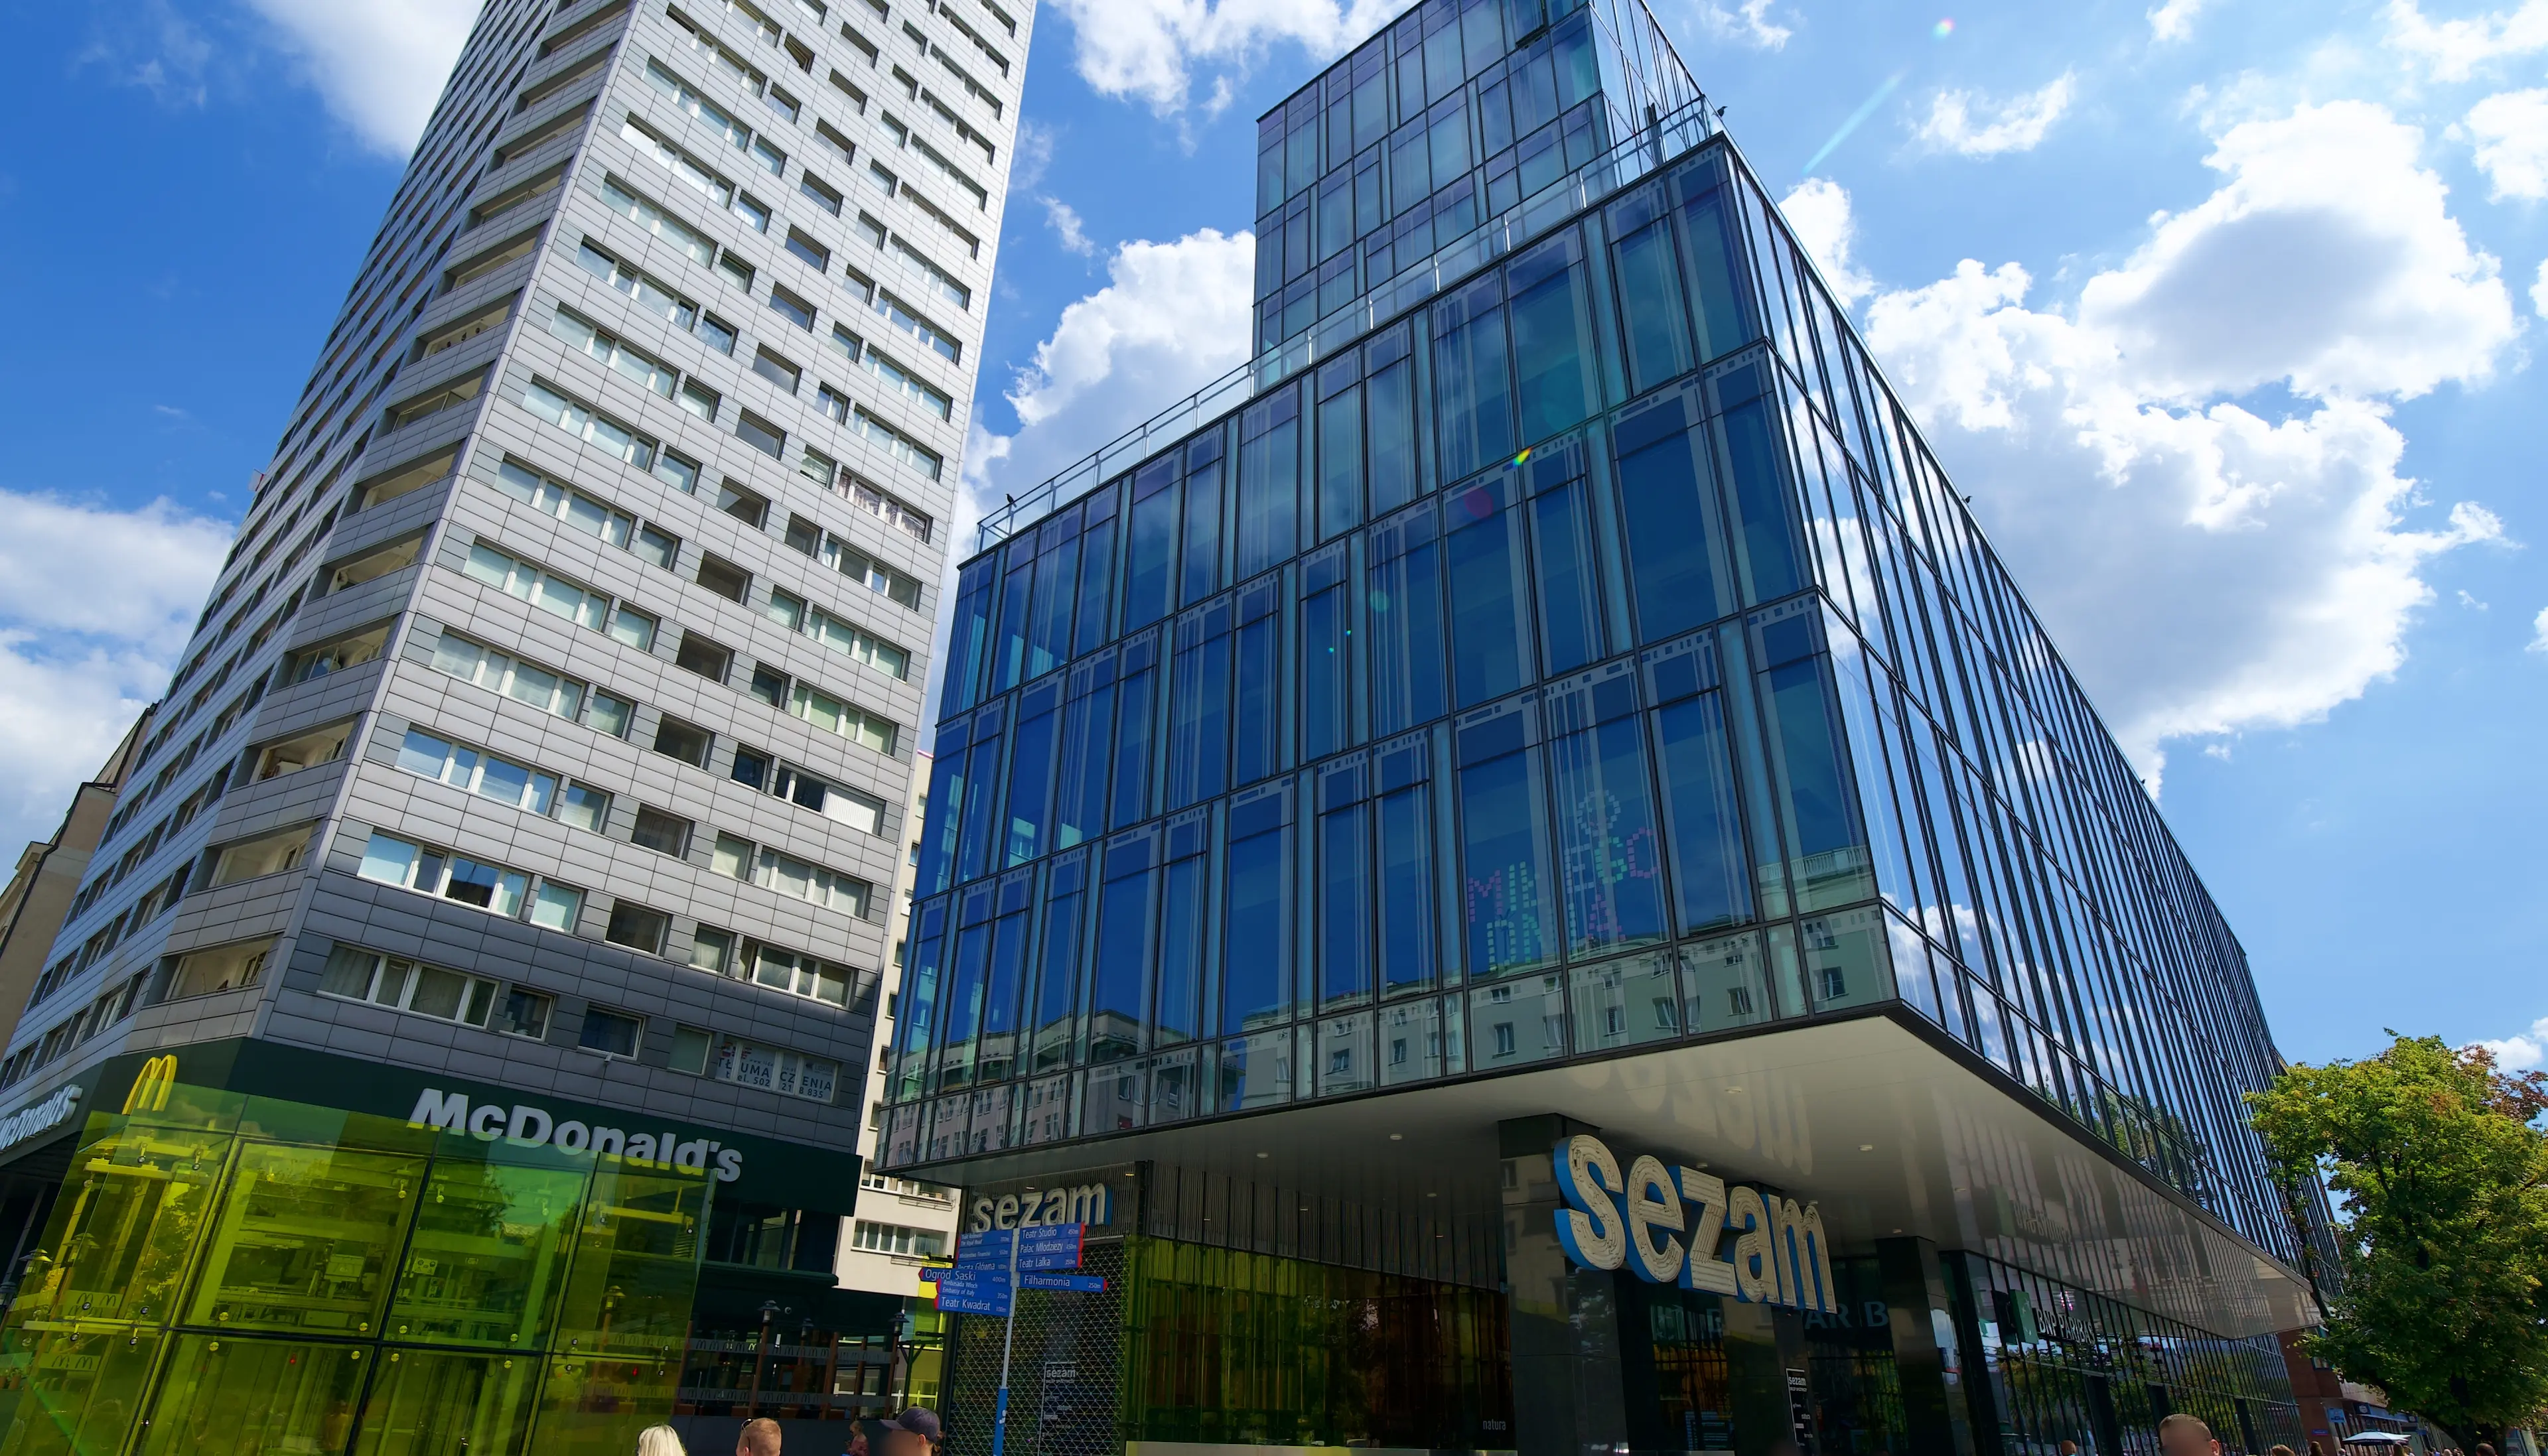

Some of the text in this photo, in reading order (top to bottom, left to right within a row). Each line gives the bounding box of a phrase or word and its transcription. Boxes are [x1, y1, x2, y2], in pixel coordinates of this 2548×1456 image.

[718, 1057, 832, 1091] TŁUMACZENIA
[753, 1077, 770, 1087] 502
[807, 1088, 823, 1098] 835
[407, 1088, 744, 1183] McDonald's
[971, 1182, 1111, 1233] sezam
[1554, 1134, 1837, 1314] sezam
[1023, 1230, 1037, 1238] Teatr
[1038, 1228, 1057, 1238] Studio
[1020, 1244, 1034, 1253] Pałac
[1036, 1240, 1064, 1252] Młodzieży
[1019, 1258, 1034, 1268] Teatr
[1035, 1256, 1050, 1267] Lalka
[926, 1269, 951, 1281] Ogród
[955, 1270, 976, 1281] Saski
[1024, 1274, 1070, 1287] Filharmonia
[941, 1297, 960, 1307] Teatr
[962, 1298, 991, 1311] Kwadrat
[2036, 1308, 2096, 1345] BNP PARIBAS
[1482, 1418, 1506, 1431] natura
